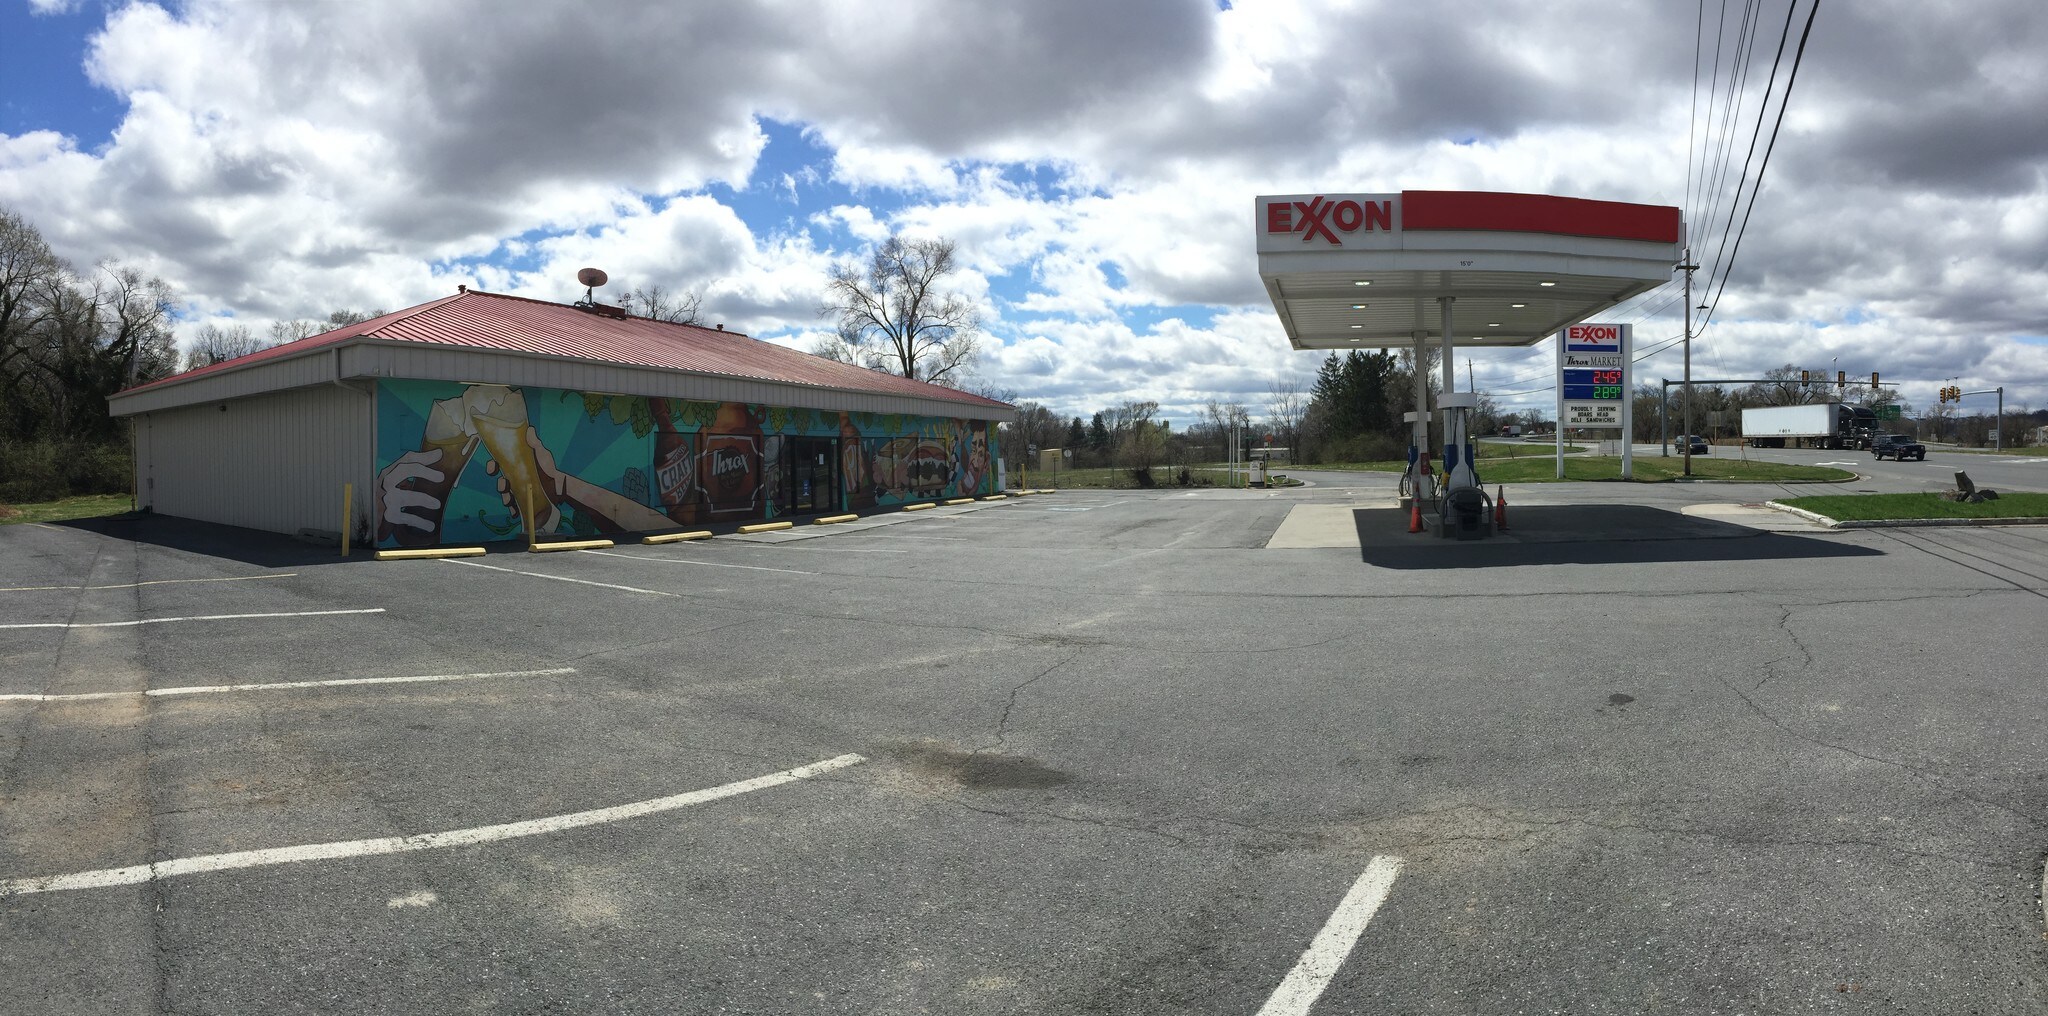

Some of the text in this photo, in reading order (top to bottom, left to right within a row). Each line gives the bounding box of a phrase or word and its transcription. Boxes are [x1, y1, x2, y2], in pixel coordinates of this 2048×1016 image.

[1267, 196, 1391, 246] EXXON
[1570, 326, 1616, 343] EXXON
[1590, 357, 1621, 366] MARKET
[661, 455, 694, 491] CRAFT
[707, 448, 749, 476] Throx
